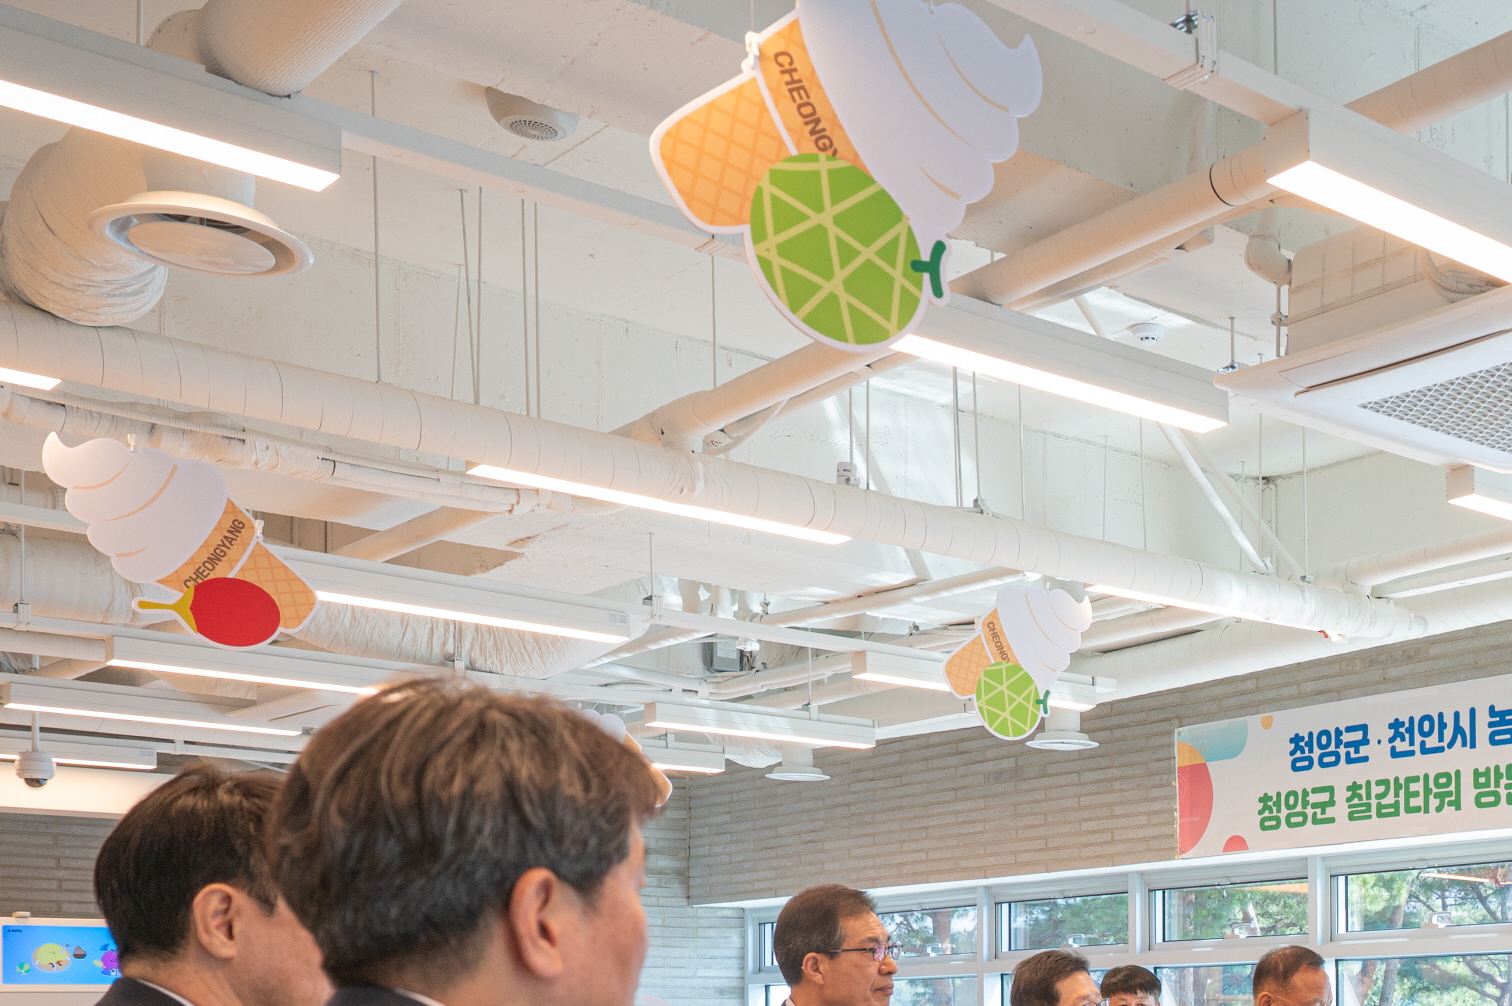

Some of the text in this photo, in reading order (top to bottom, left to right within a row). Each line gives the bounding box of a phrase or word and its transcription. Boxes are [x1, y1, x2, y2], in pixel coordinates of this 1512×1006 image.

[183, 518, 246, 589] CHEONGYANG
[1257, 785, 1337, 832] 청양군
[1345, 769, 1463, 822] 칠갑타워
